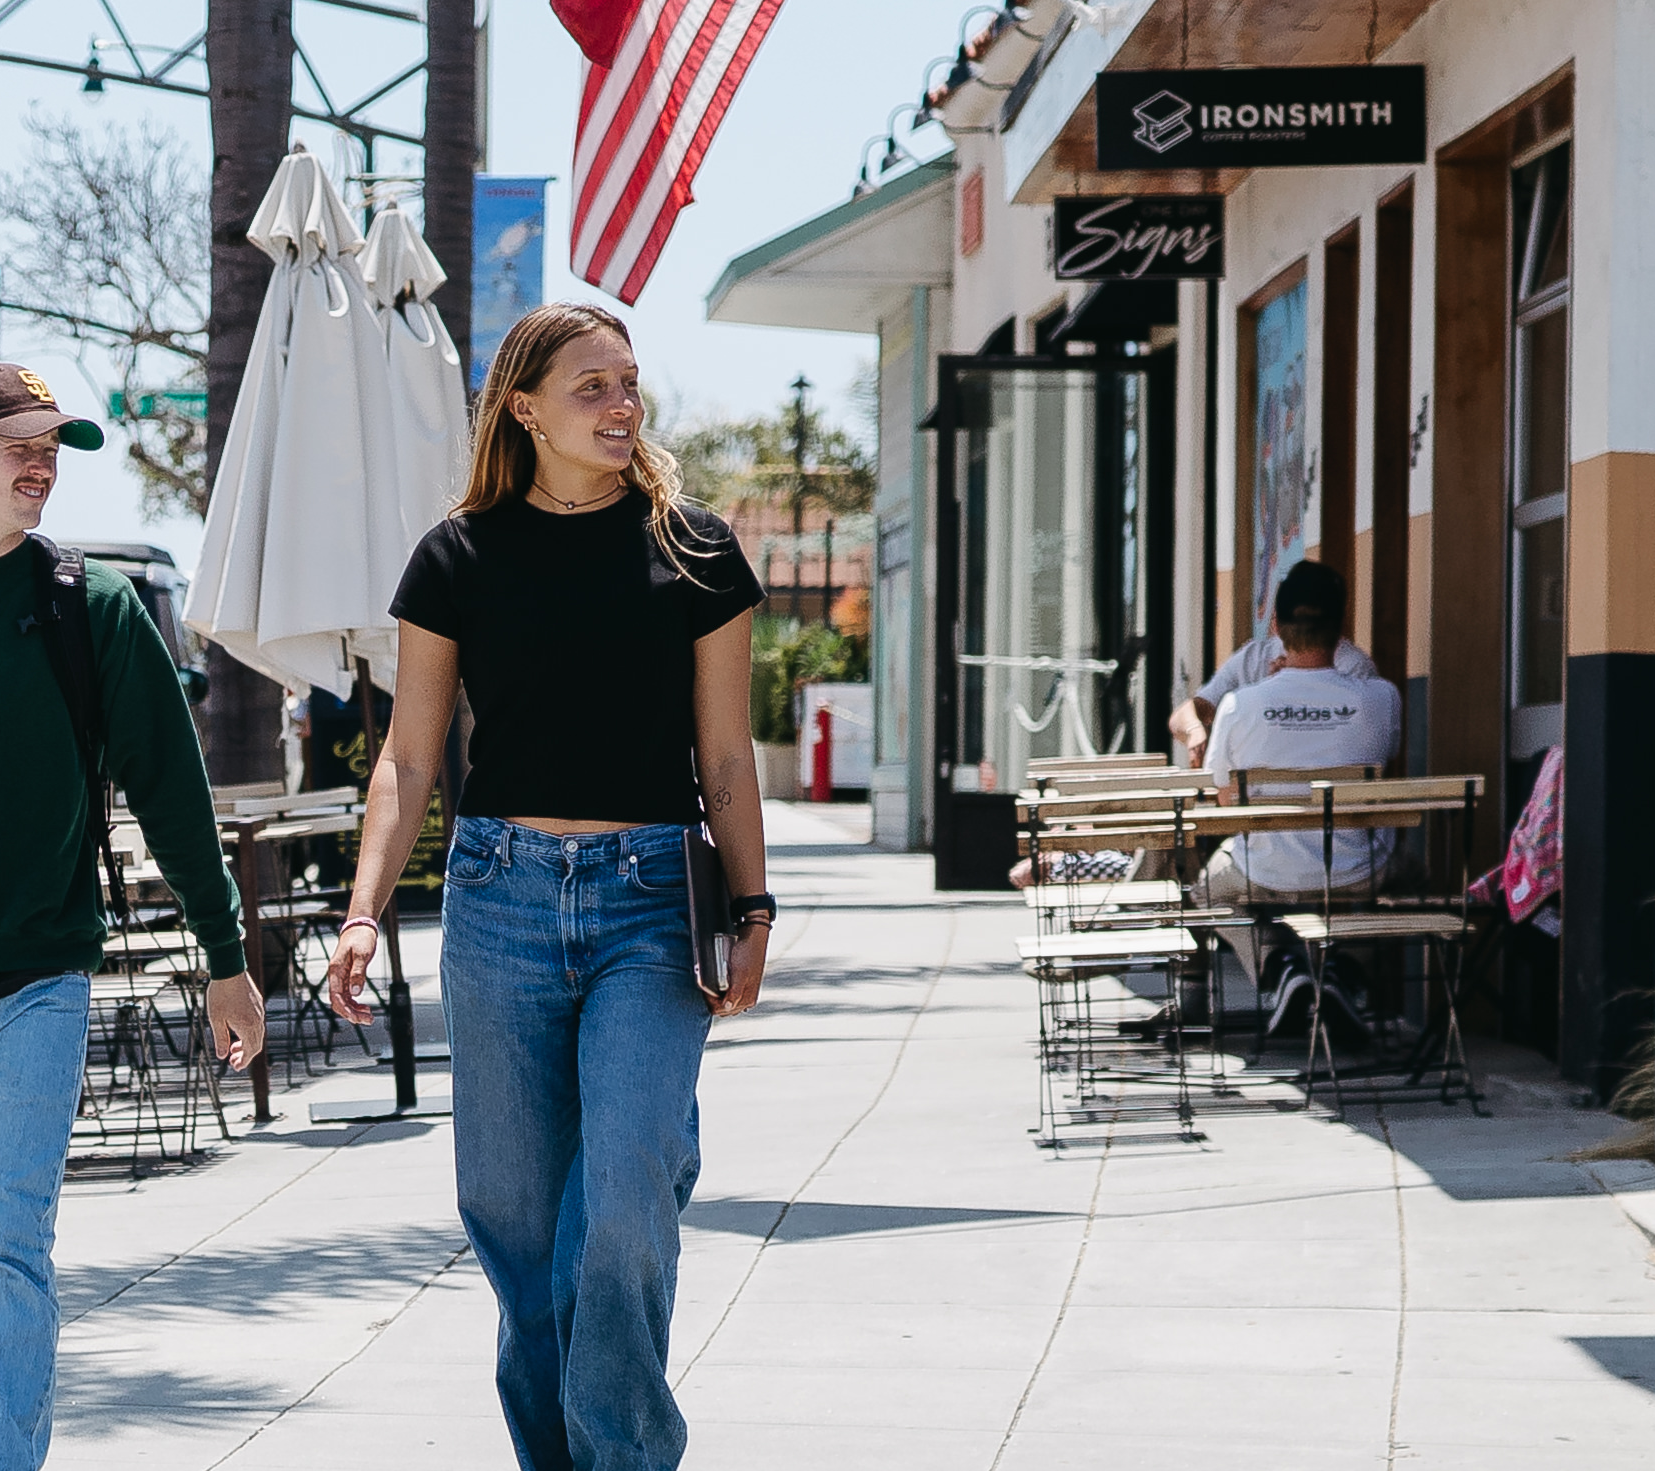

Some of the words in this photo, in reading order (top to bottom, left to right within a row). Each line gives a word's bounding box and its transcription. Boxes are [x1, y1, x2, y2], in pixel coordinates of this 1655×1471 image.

[1200, 102, 1392, 129] IRONSMITH
[1058, 197, 1225, 279] Signs
[1264, 706, 1332, 721] adidas
